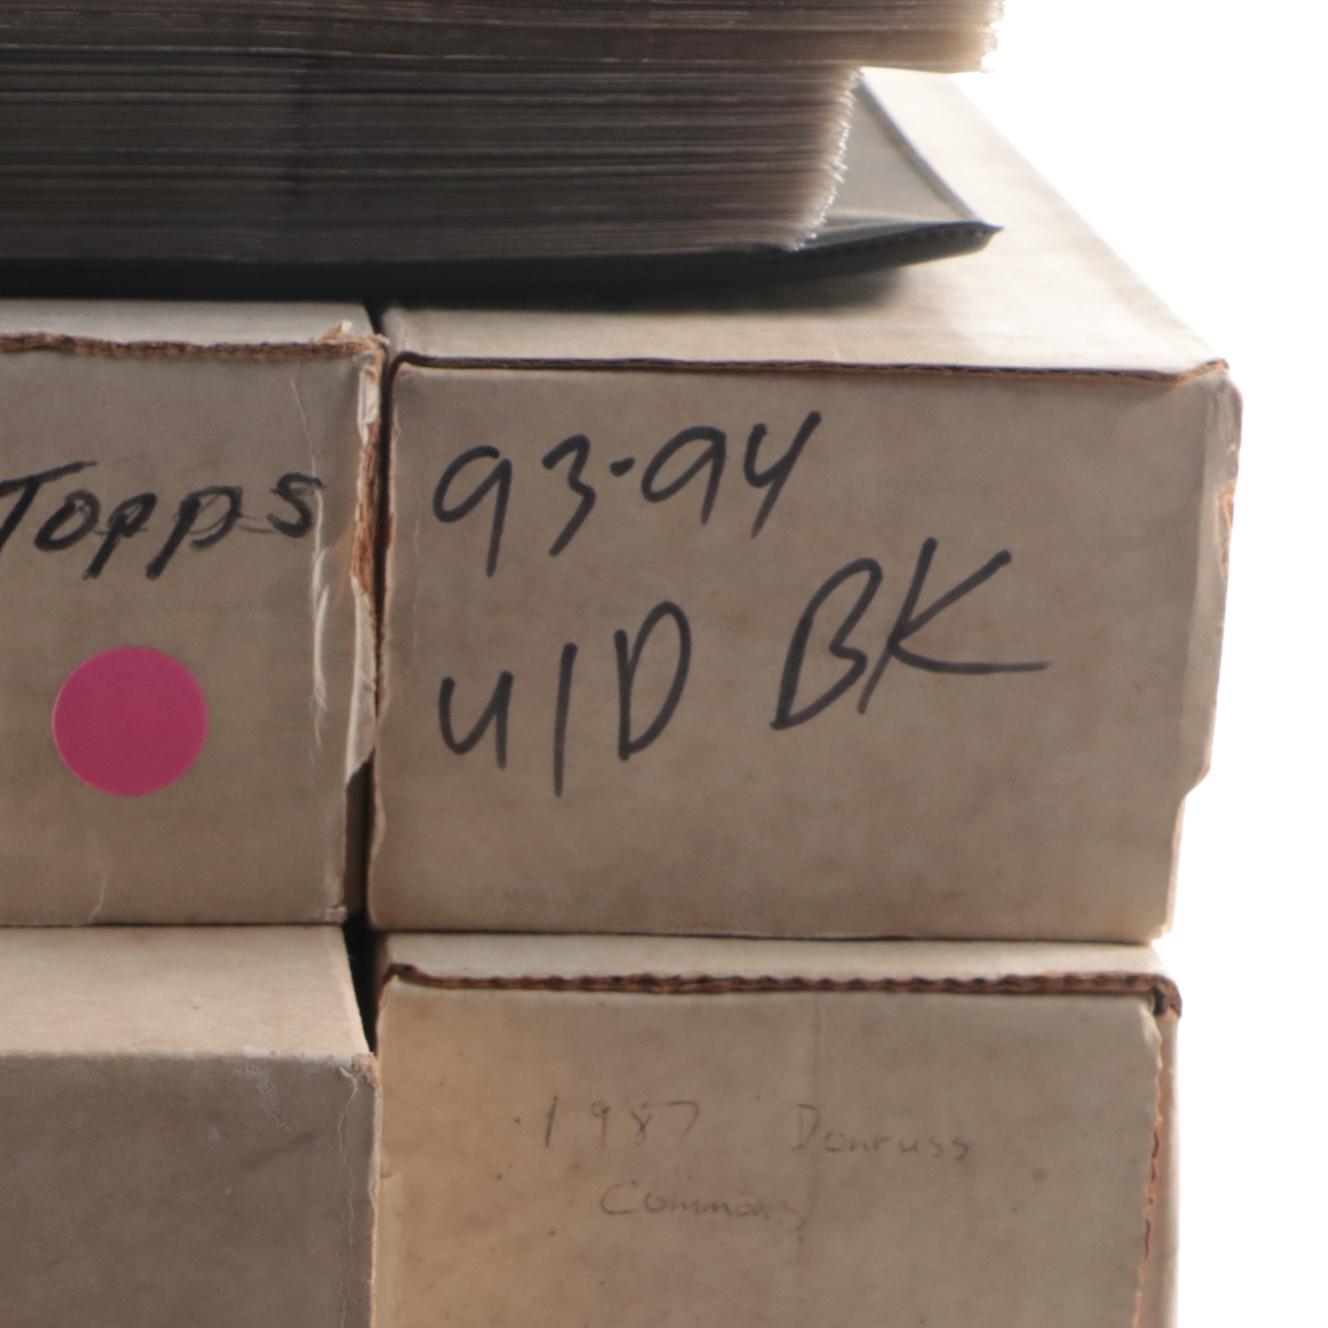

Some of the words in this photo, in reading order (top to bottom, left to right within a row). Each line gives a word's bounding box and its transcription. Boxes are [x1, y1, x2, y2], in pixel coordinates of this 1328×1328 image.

[432, 411, 822, 577] 93-94
[771, 537, 1051, 730] BK
[544, 1096, 701, 1150] 1987
